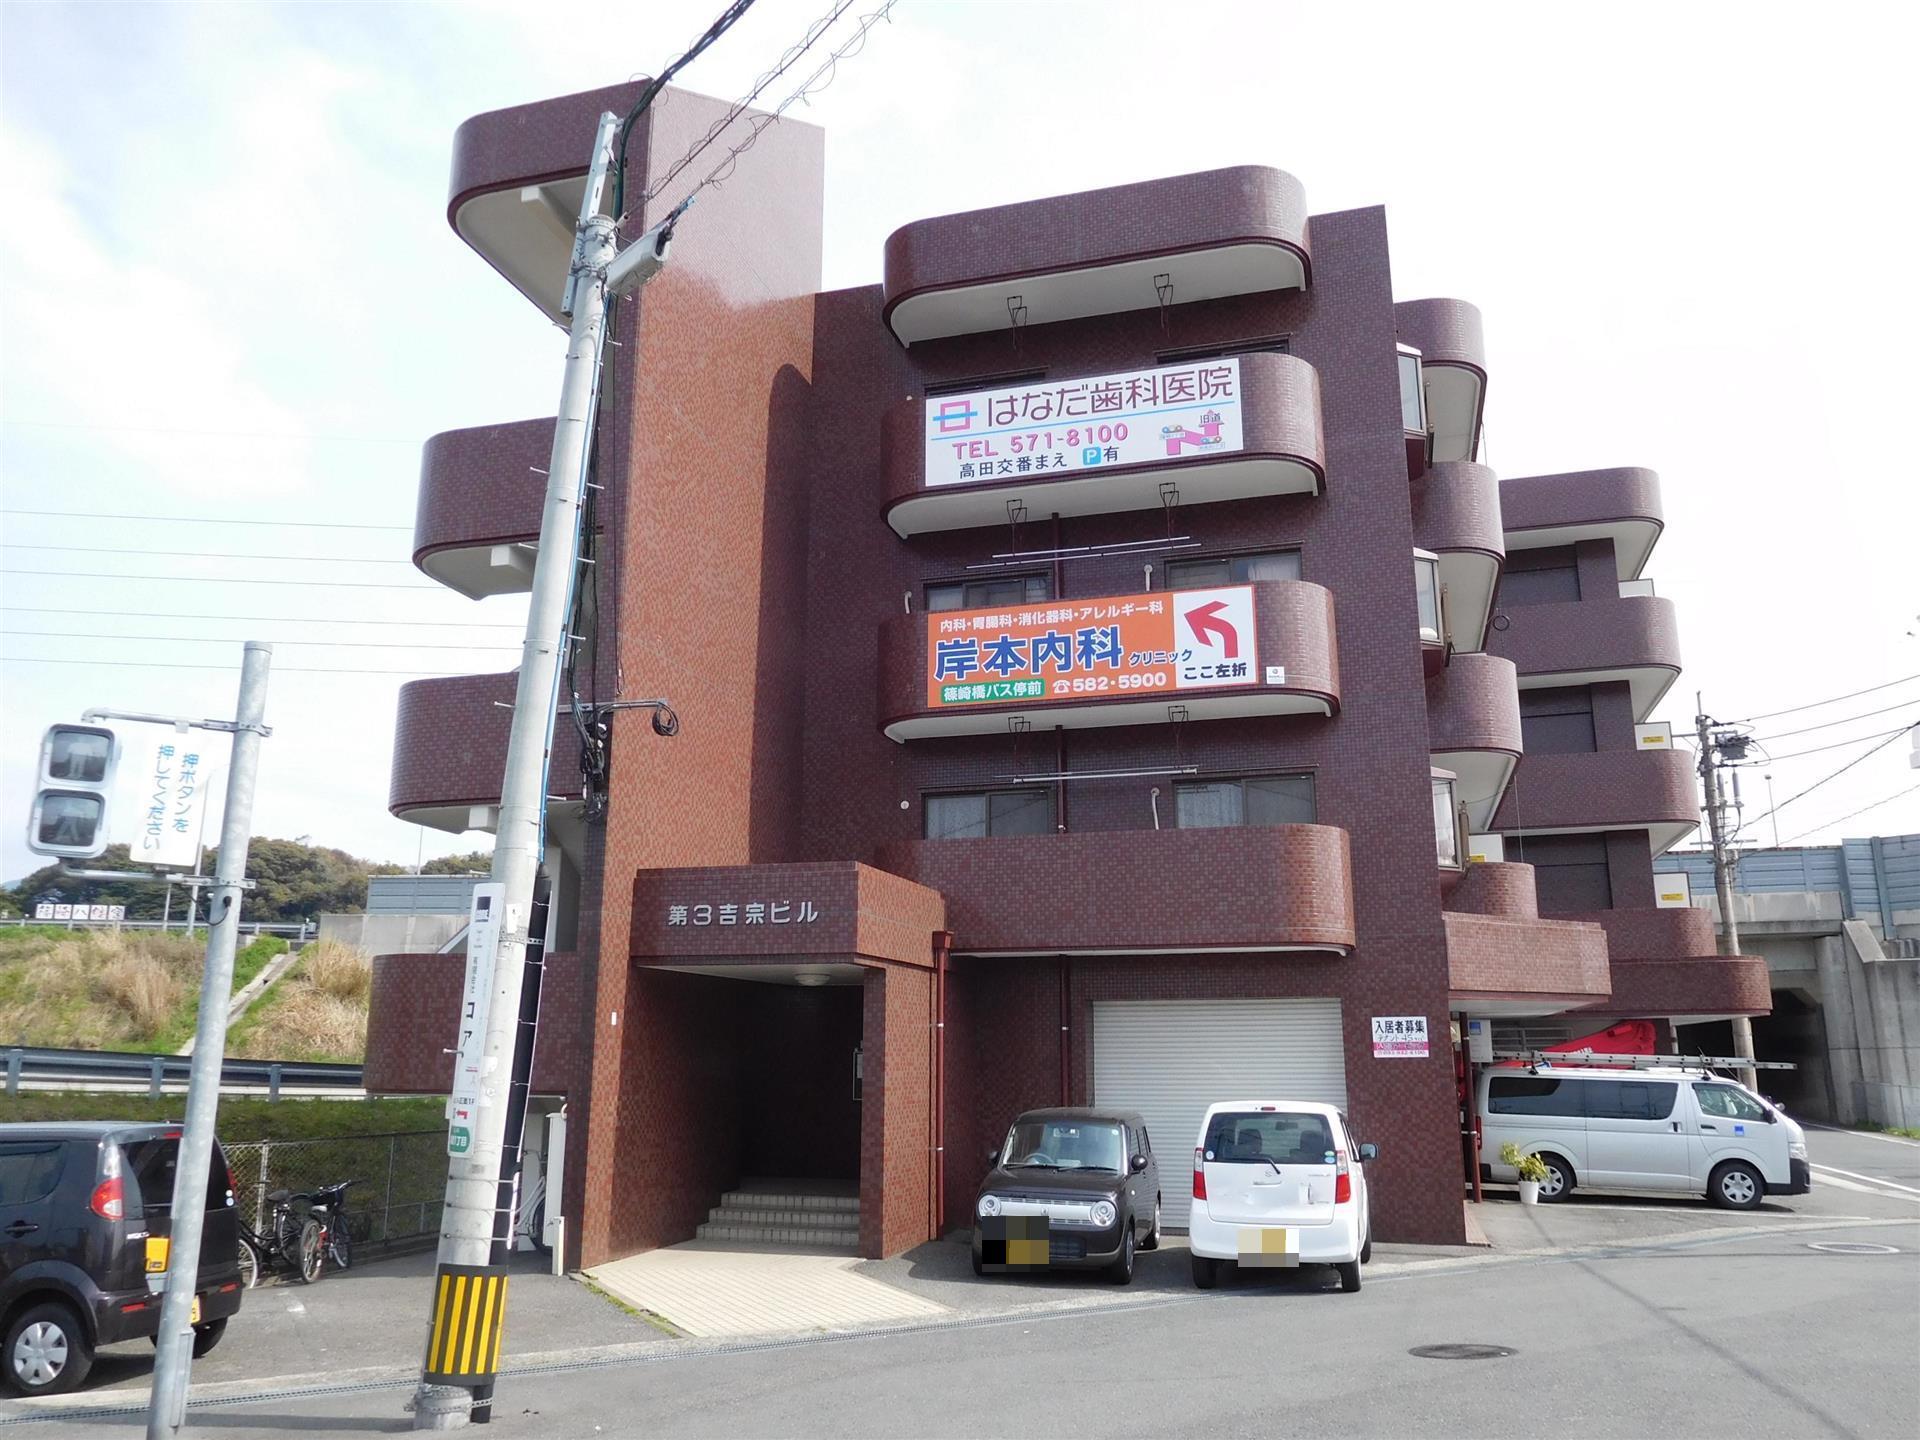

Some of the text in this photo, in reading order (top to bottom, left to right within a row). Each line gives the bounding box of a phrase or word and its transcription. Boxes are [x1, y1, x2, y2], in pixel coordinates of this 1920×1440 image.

[987, 366, 1233, 427] はなだ歯科医院
[952, 423, 1129, 459] TEL 571-8100
[959, 453, 1068, 479] 高田交番まえ
[934, 624, 1192, 681] 岸本内科 クリニック
[1184, 662, 1247, 680] ここ左折
[944, 681, 1042, 702] 篠崎橋バス停前
[668, 900, 819, 926] 第3吉宗ビル
[1375, 1020, 1424, 1034] 入居者募集
